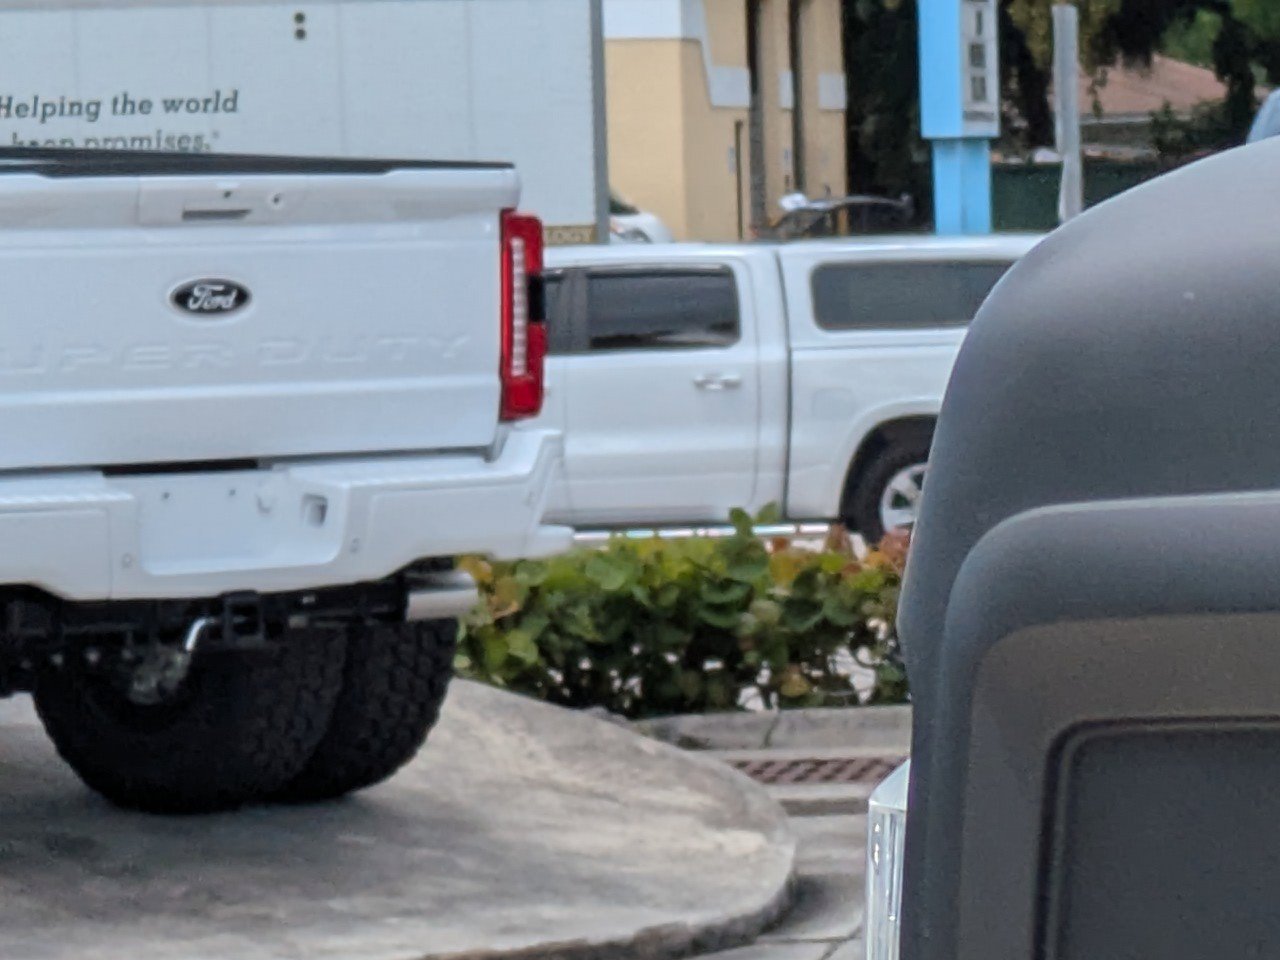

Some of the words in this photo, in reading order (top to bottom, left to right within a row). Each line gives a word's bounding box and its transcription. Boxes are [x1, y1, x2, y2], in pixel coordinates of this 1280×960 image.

[0, 95, 101, 124] Helping
[111, 91, 153, 116] the
[162, 89, 239, 114] world
[187, 283, 238, 311] Ford
[257, 334, 472, 367] DUTY
